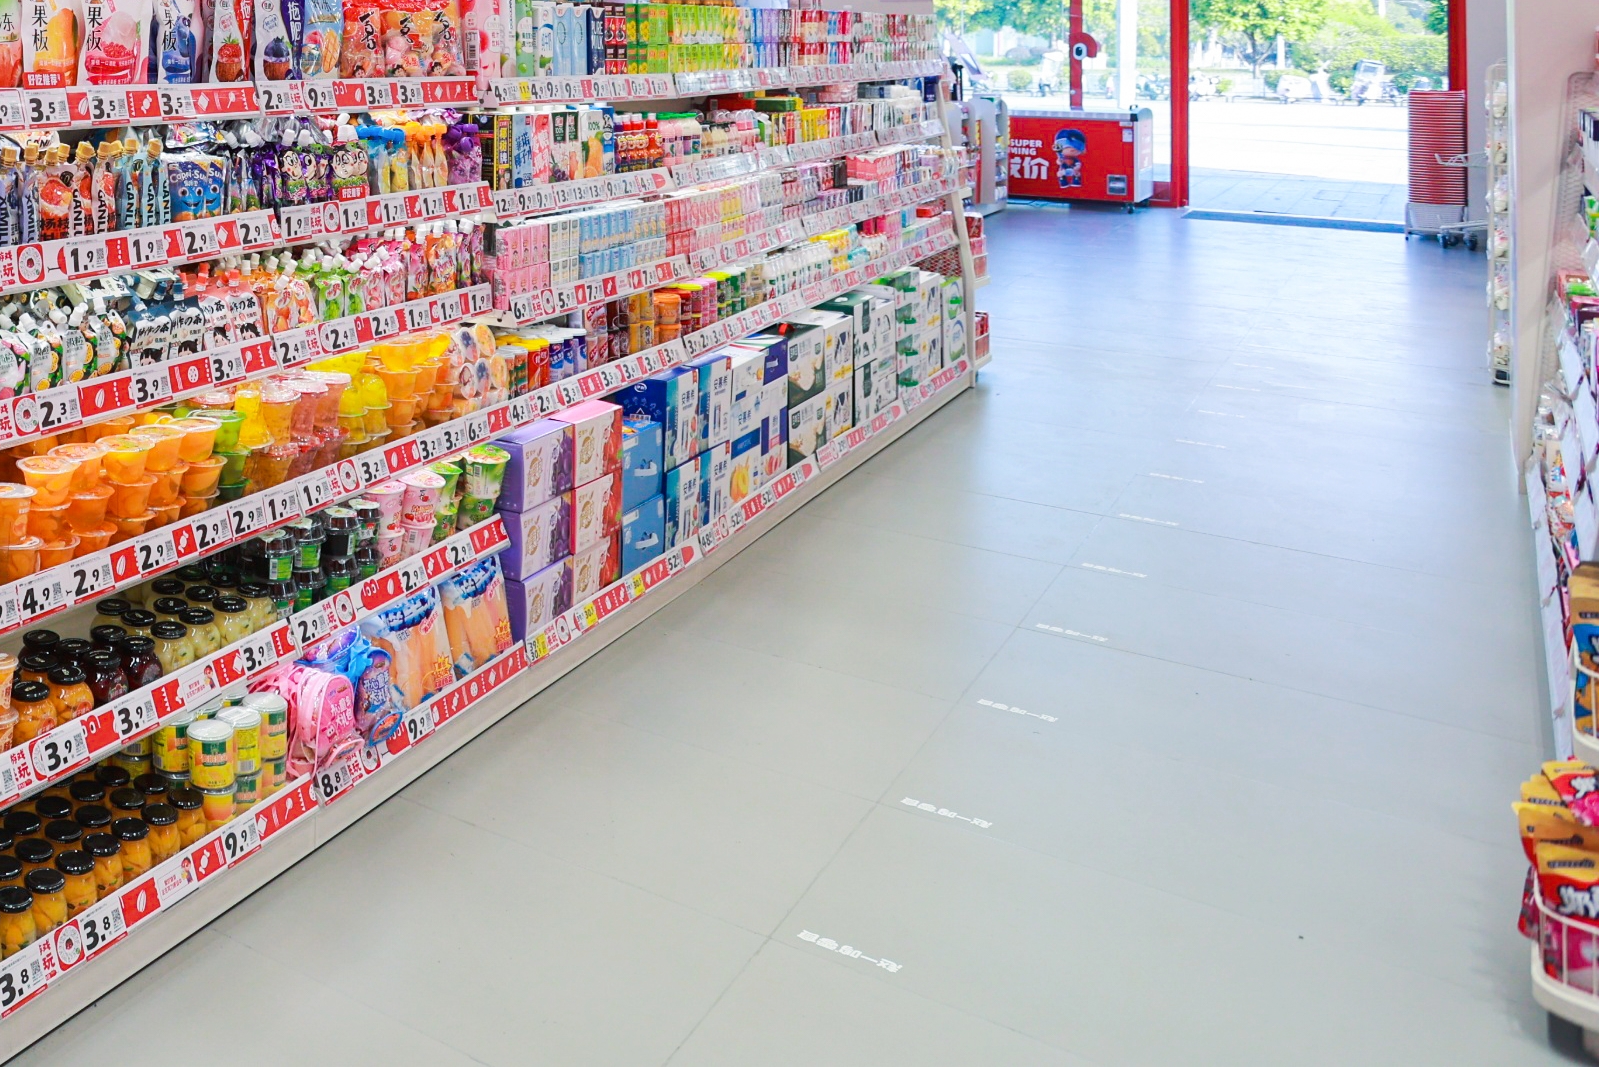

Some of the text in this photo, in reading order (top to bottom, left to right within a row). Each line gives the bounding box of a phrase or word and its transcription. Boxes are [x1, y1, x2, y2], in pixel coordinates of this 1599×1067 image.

[31, 5, 50, 52] 果板
[162, 7, 177, 52] 果板
[287, 1, 301, 42] 拖肥
[27, 73, 57, 86] 好吃推荐
[29, 97, 56, 123] 3.5
[92, 95, 117, 119] 3.5
[161, 93, 183, 117] 3.5
[264, 89, 284, 111] 2.8
[1010, 139, 1043, 148] SUPER
[185, 230, 208, 254] 2.9
[240, 222, 262, 246] 2.9
[72, 247, 95, 272] 1.9
[132, 238, 155, 263] 1.9
[136, 380, 160, 404] 3.9
[40, 402, 68, 428] 2.3
[268, 498, 289, 521] 1.9
[197, 524, 220, 547] 2.9
[233, 512, 255, 535] 2.9
[140, 545, 164, 571] 2.9
[73, 569, 100, 596] 2.9
[22, 587, 51, 617] 4.9
[244, 648, 266, 671] 3.9
[118, 704, 144, 732] 3.9
[45, 739, 73, 770] 3.9
[321, 769, 342, 796] 8.8
[900, 796, 993, 829] 赵一鸣零食
[225, 829, 249, 858] 9.9
[84, 916, 111, 950] 3.8
[796, 929, 903, 974] 赵一鸣零食
[0, 969, 30, 1006] 3.8
